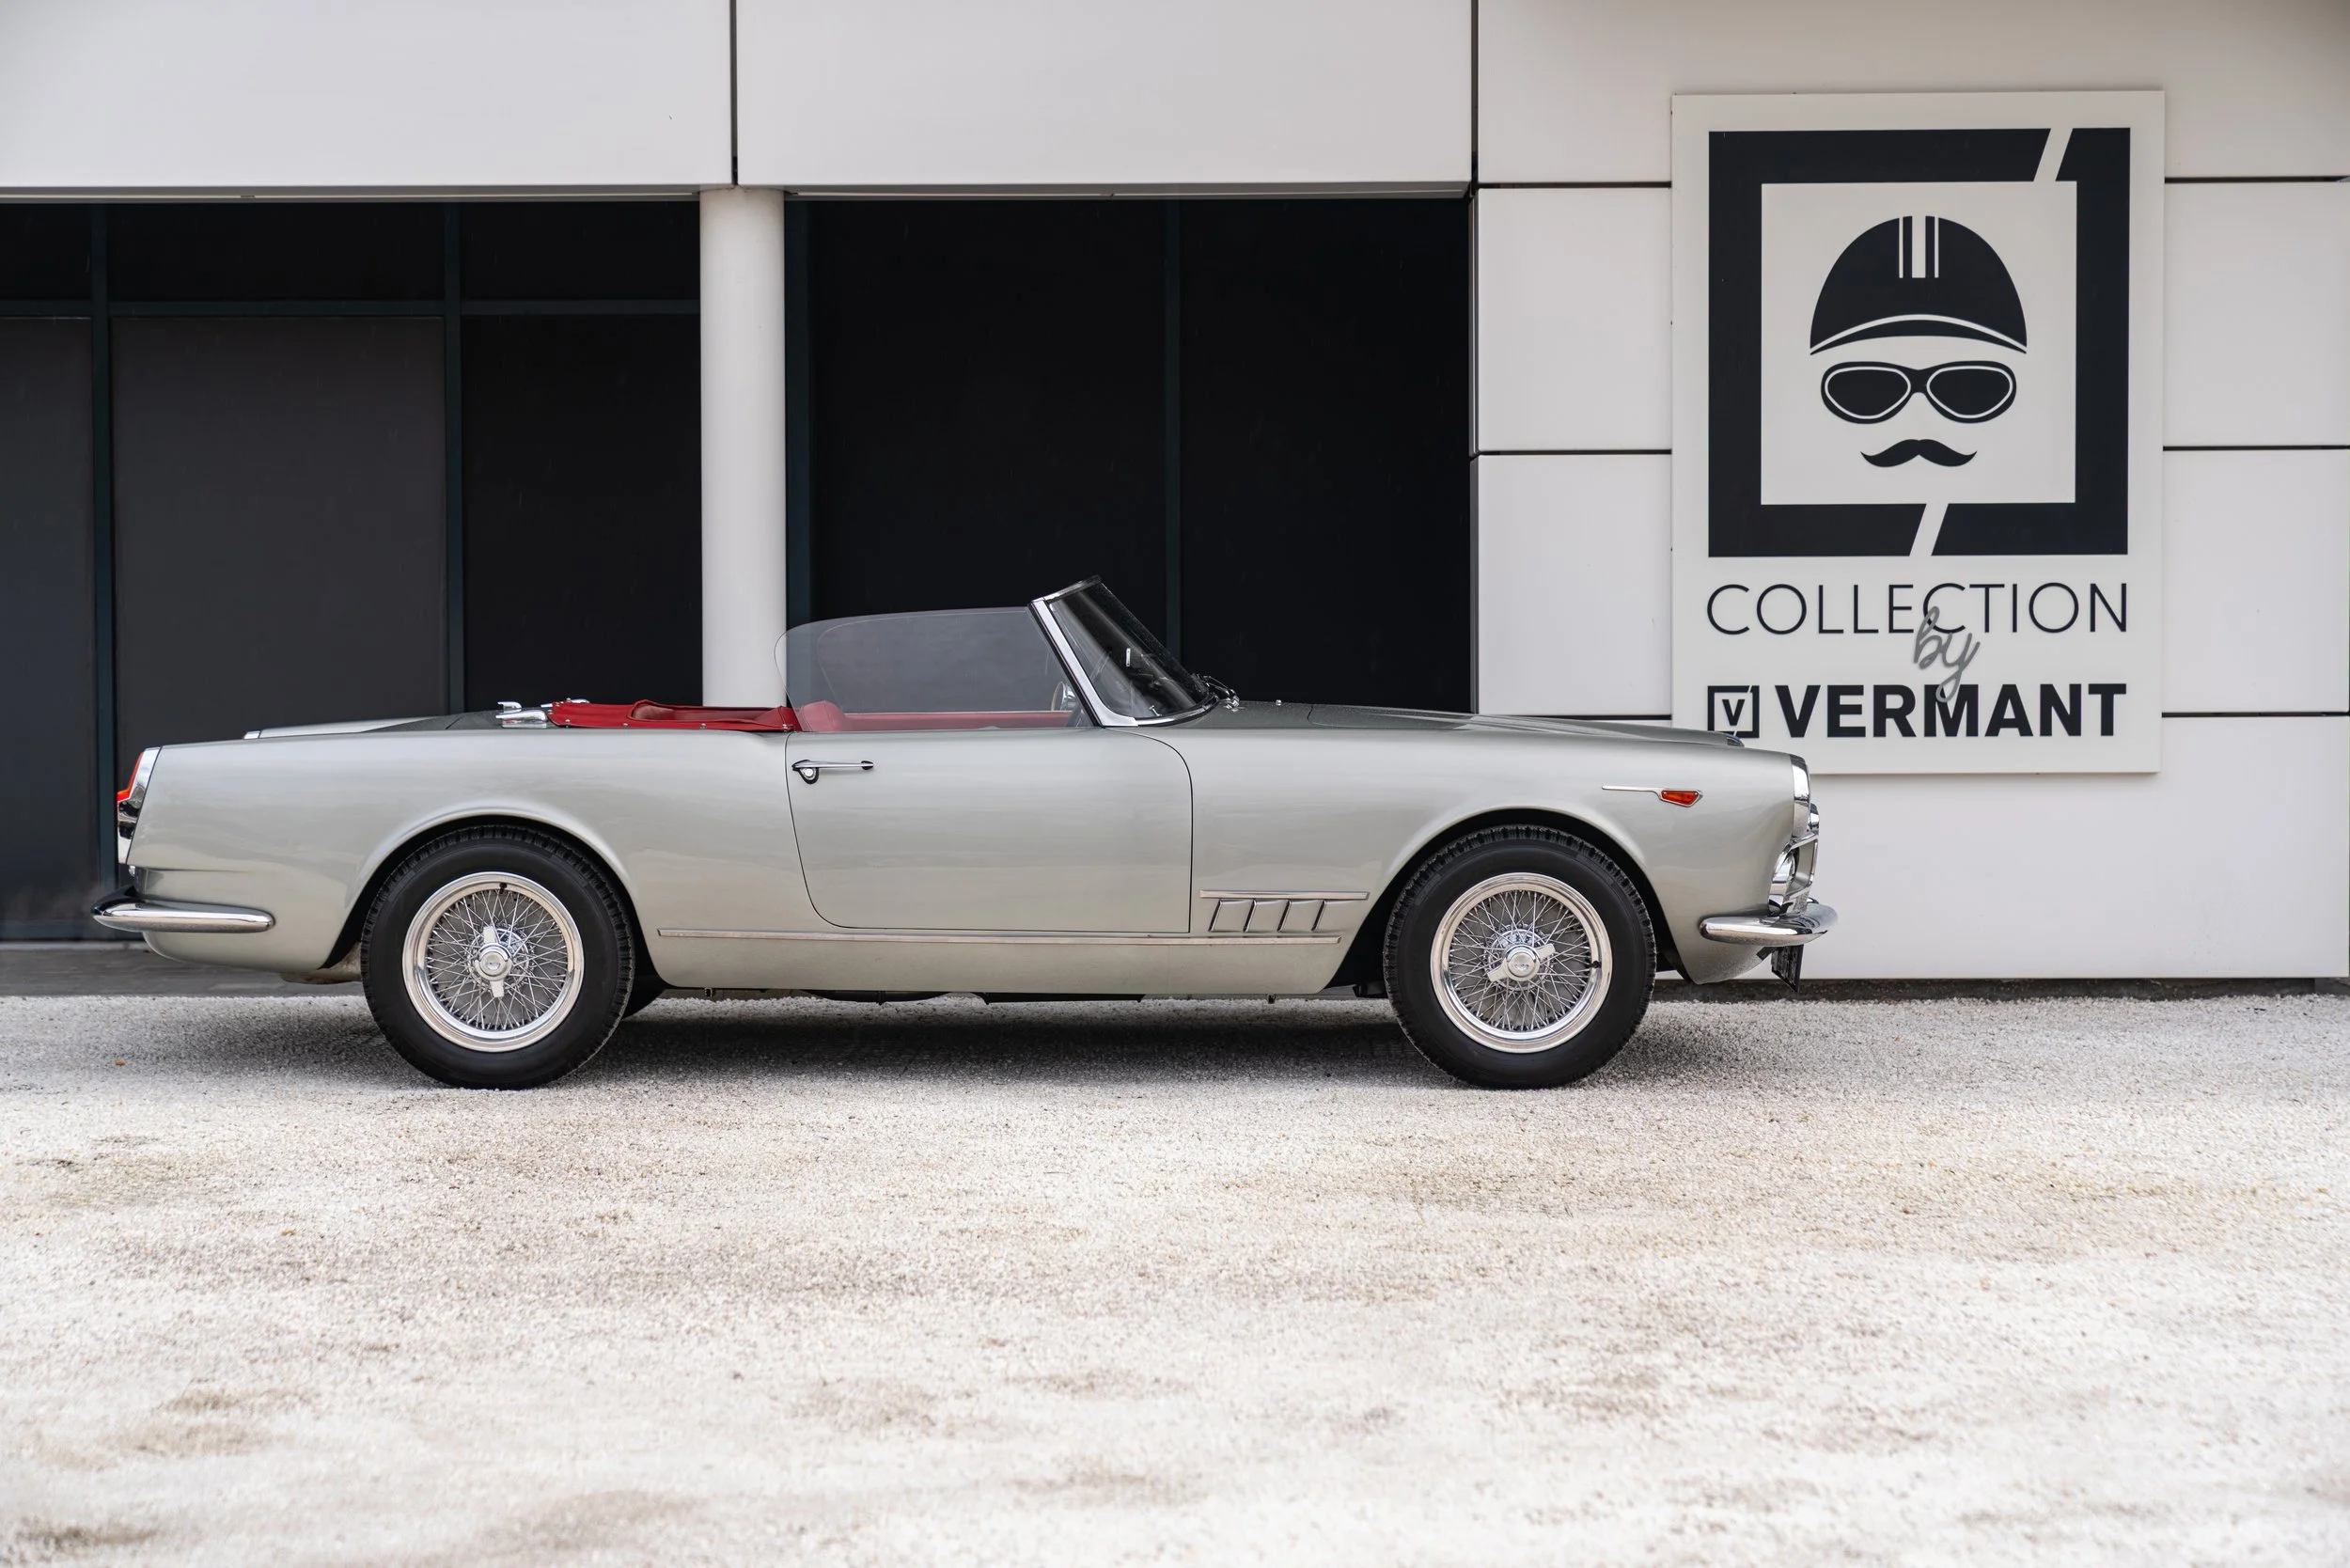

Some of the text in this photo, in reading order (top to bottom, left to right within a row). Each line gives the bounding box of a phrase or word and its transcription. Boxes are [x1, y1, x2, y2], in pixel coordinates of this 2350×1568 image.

[1707, 582, 2127, 635] COLLECTION
[1913, 606, 1981, 703] by
[1775, 683, 2126, 738] VERMANT
